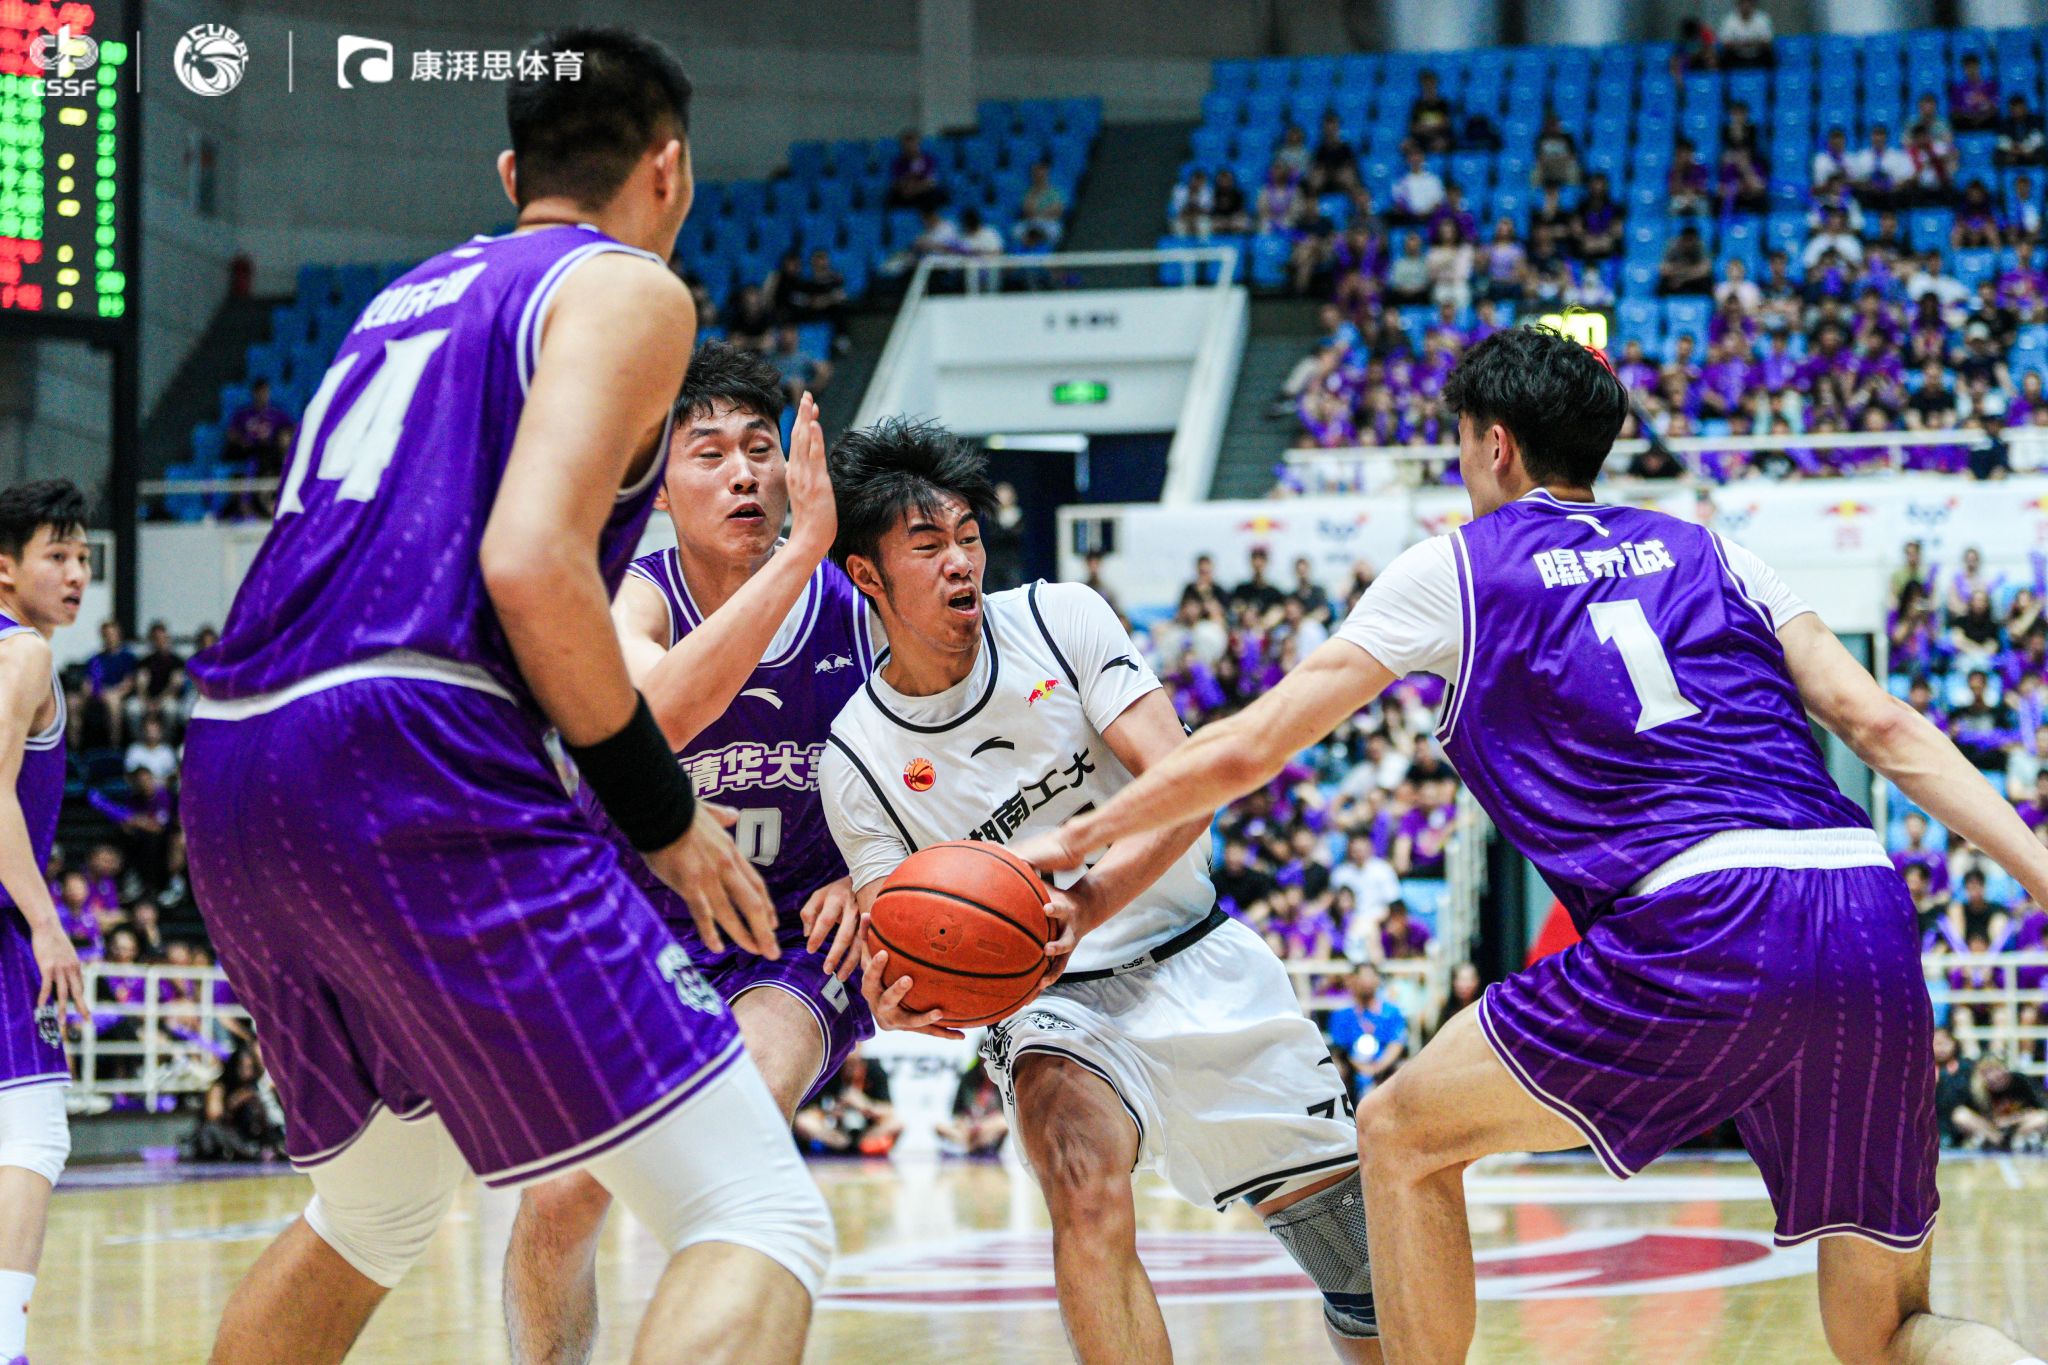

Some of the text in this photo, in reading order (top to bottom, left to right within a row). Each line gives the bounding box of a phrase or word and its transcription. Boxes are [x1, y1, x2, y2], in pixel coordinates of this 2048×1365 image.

[275, 329, 451, 520] 14
[1586, 598, 1702, 734] 1
[736, 808, 782, 867] 0
